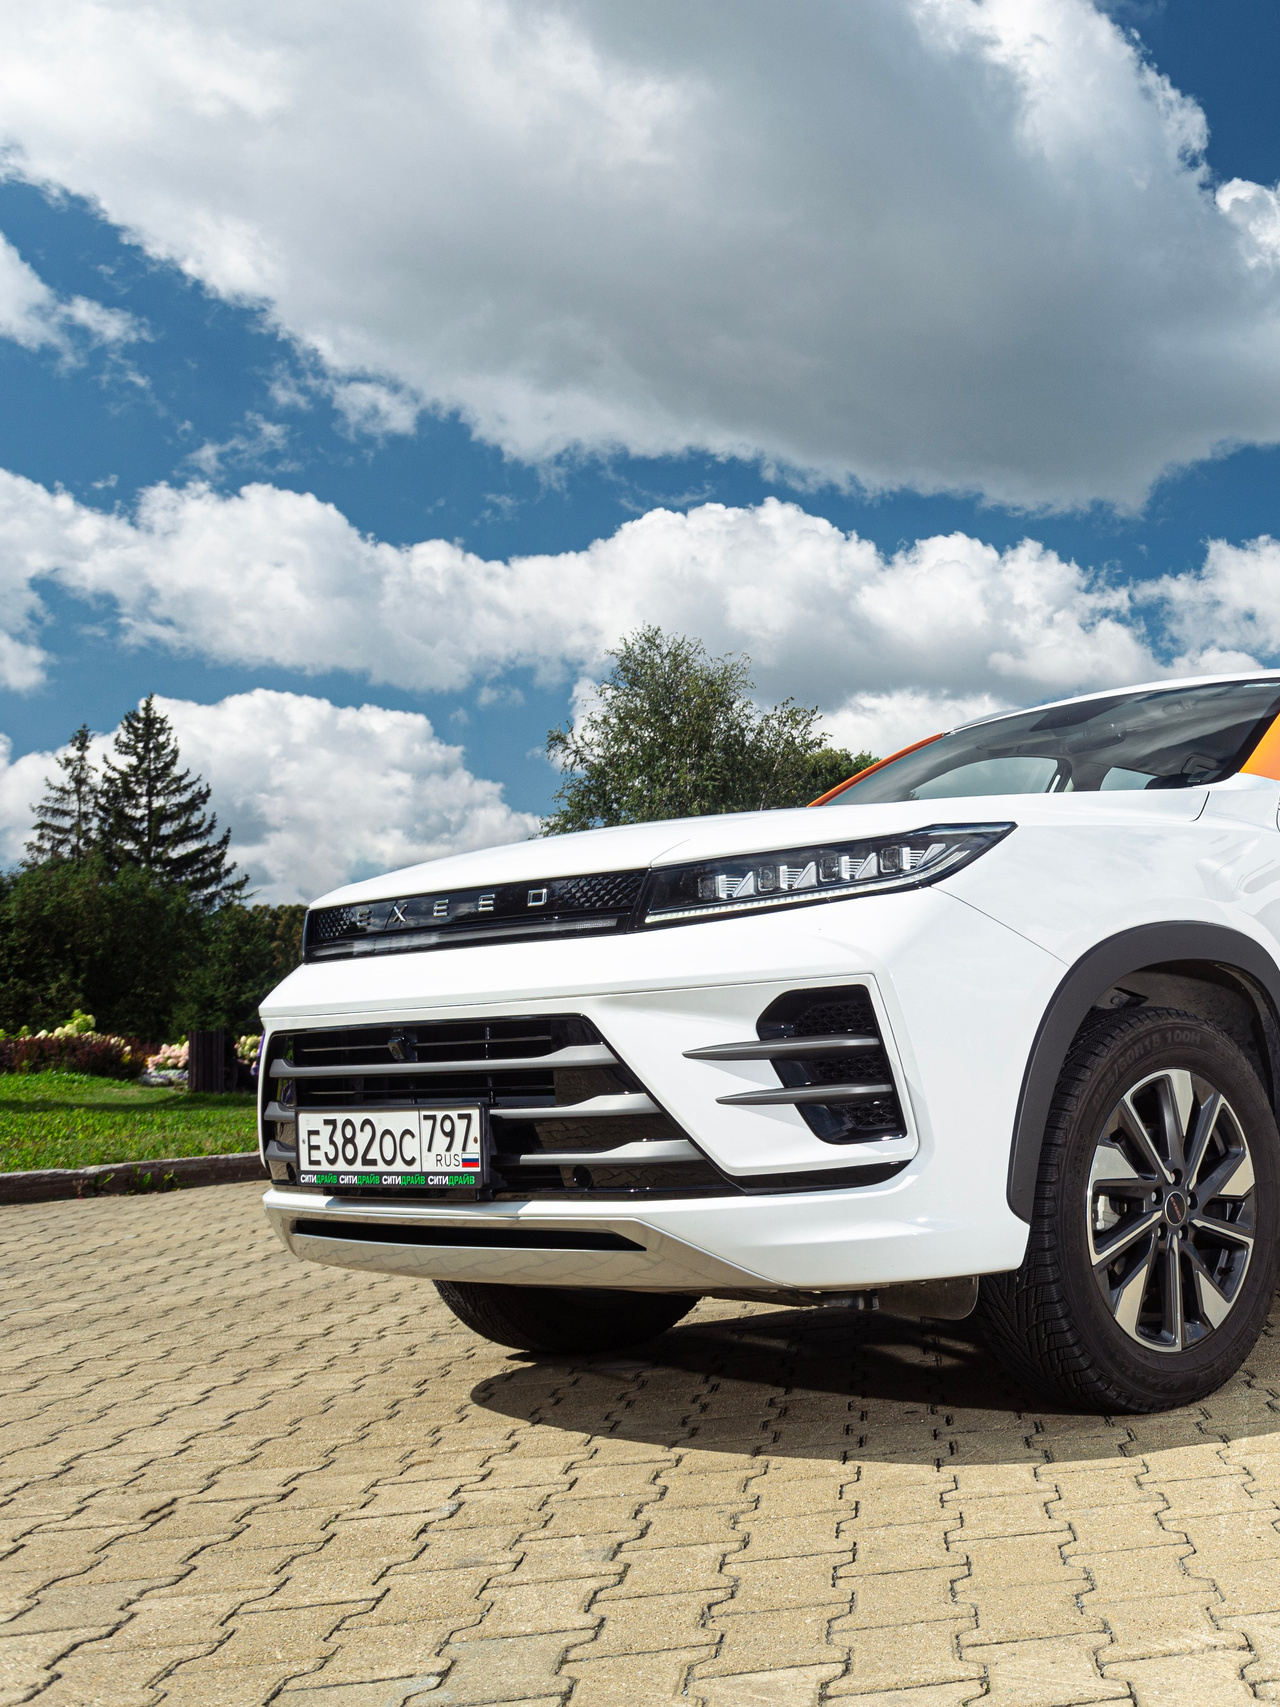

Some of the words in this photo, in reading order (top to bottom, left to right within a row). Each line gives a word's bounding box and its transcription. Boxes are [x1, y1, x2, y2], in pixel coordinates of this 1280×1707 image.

[356, 888, 548, 928] EXEED
[422, 1113, 473, 1153] 797
[435, 1153, 461, 1168] RUS
[300, 1173, 338, 1185] СИТИДРАЙВ
[339, 1173, 380, 1186] СИТИДРАЙВ
[381, 1174, 426, 1186] СИТИДРАЙВ
[427, 1174, 475, 1186] СИТИДРАЙВ
